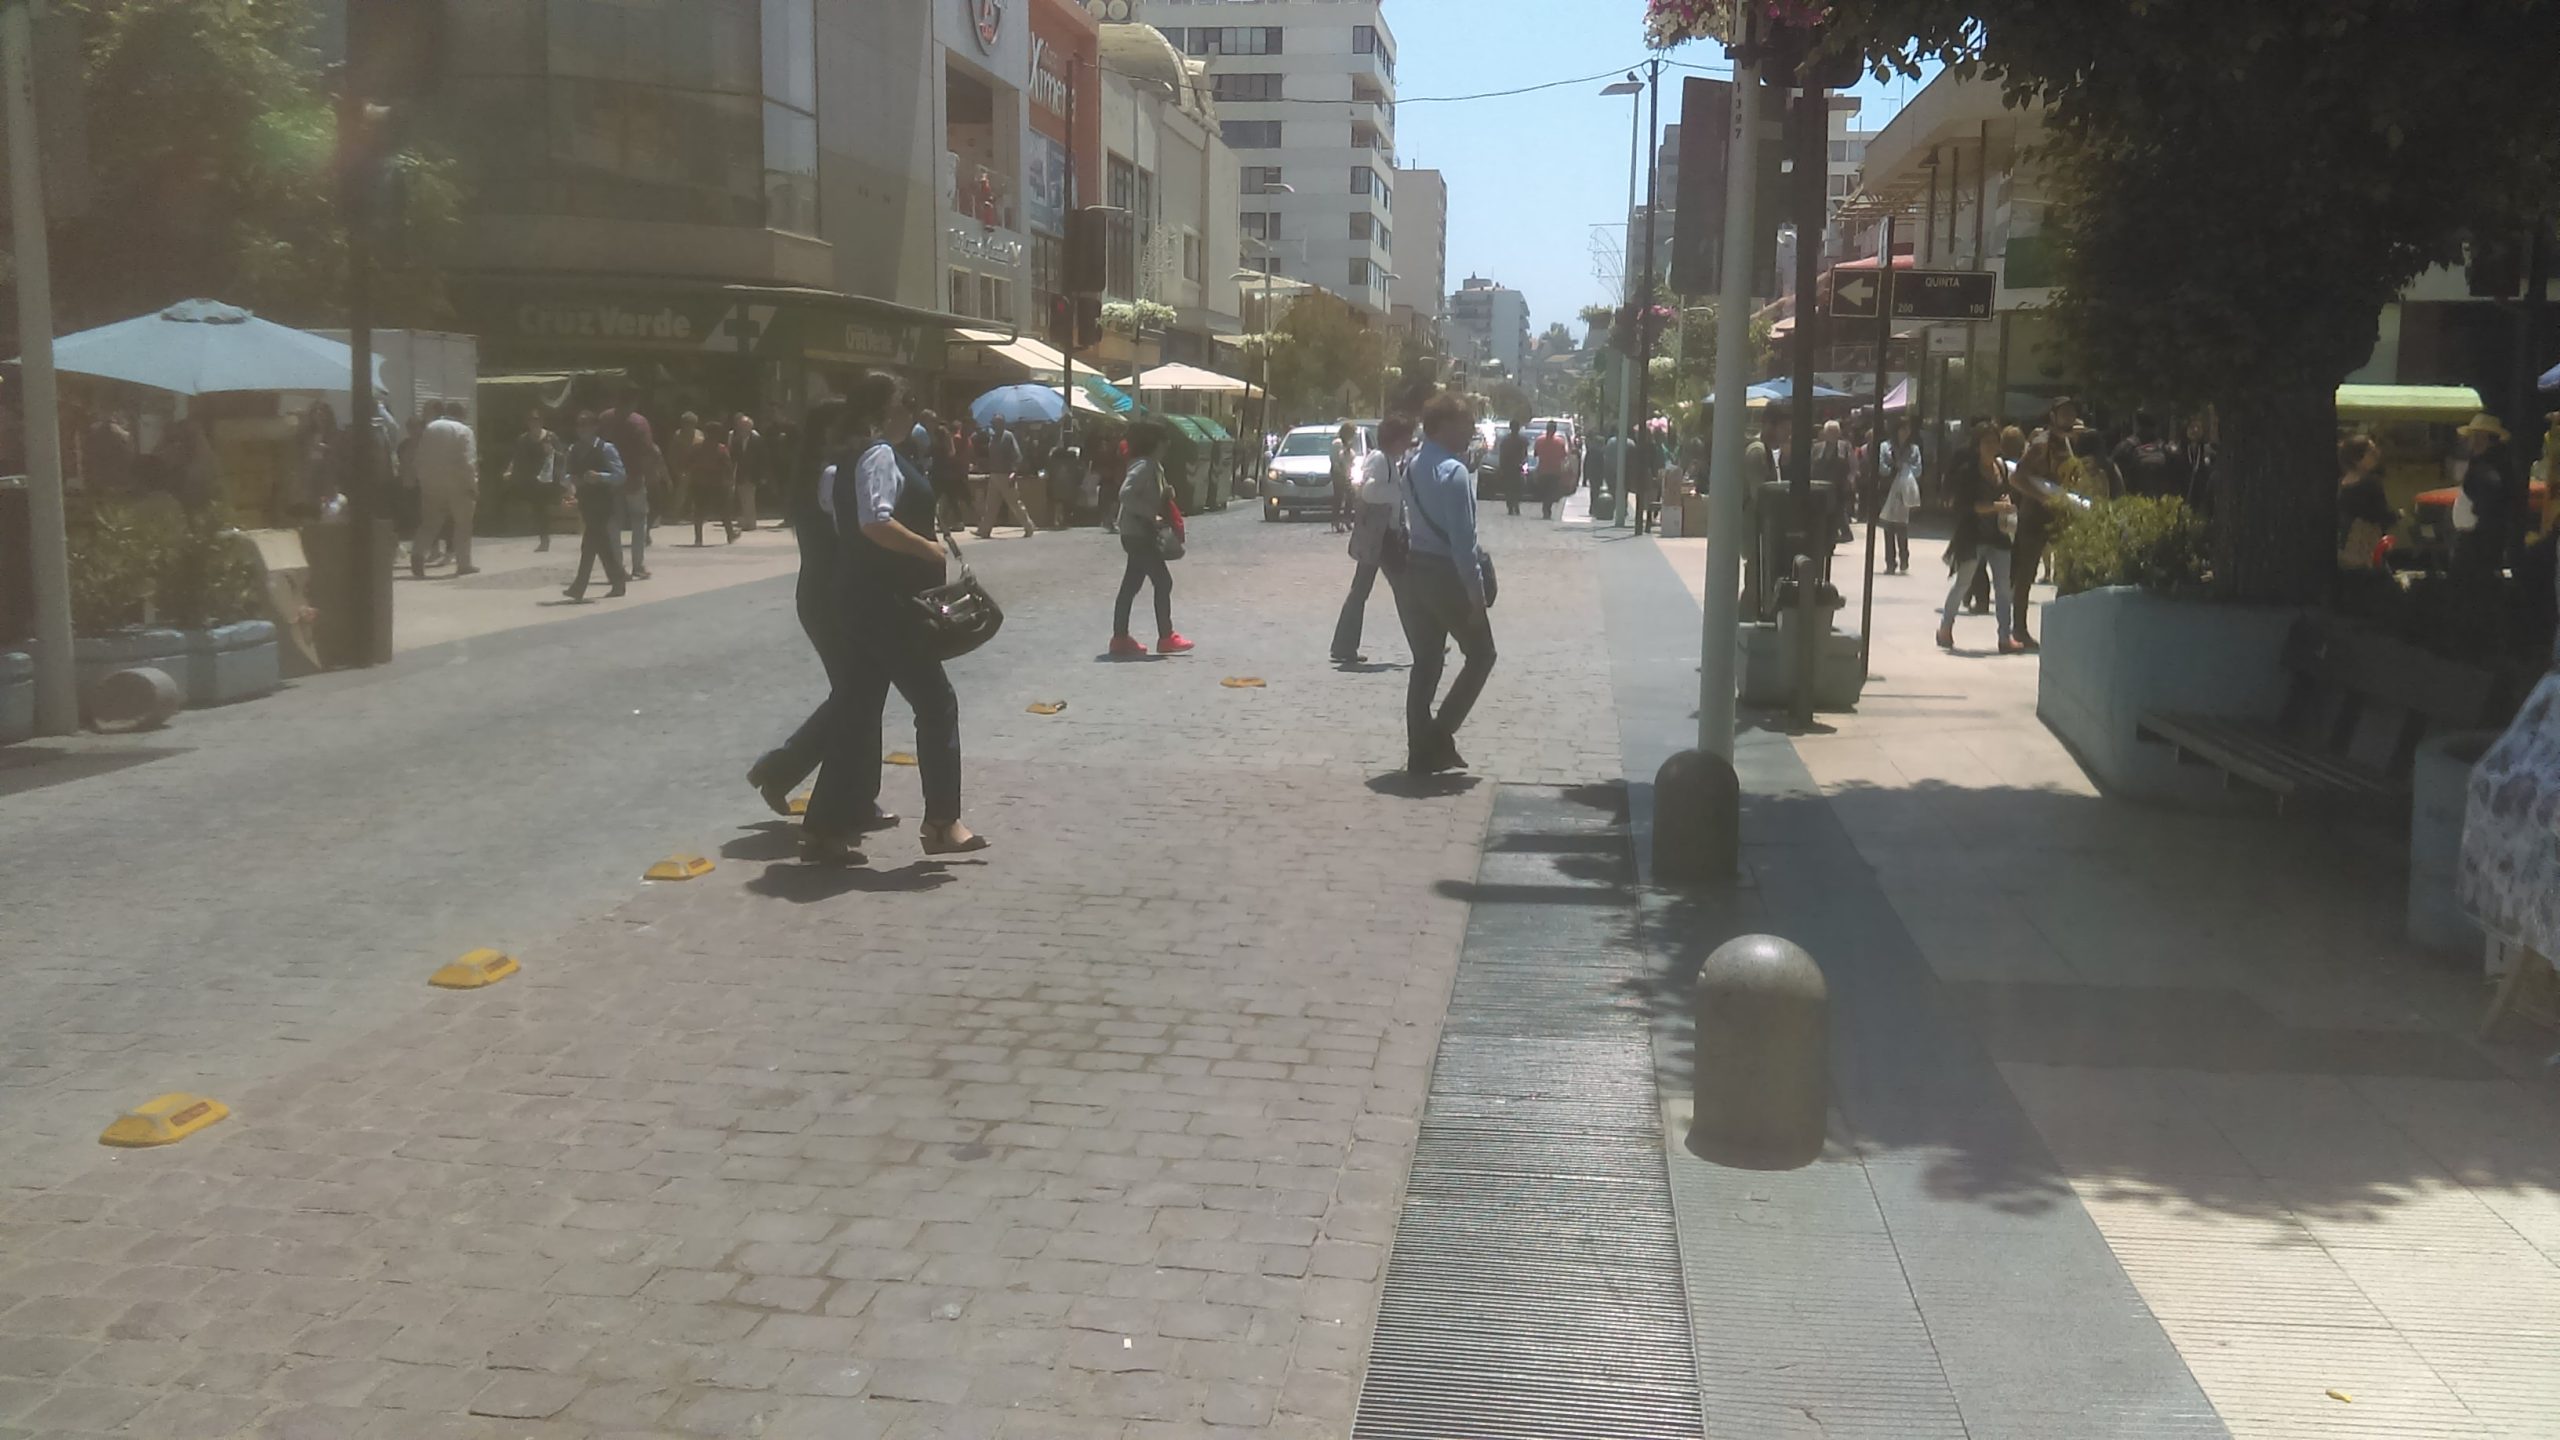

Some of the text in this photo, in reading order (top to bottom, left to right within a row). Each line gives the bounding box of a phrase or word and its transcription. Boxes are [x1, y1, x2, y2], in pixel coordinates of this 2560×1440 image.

[1924, 276, 1961, 289] QUINTA
[1897, 303, 1914, 314] 200
[516, 302, 692, 338] Cruz Verde
